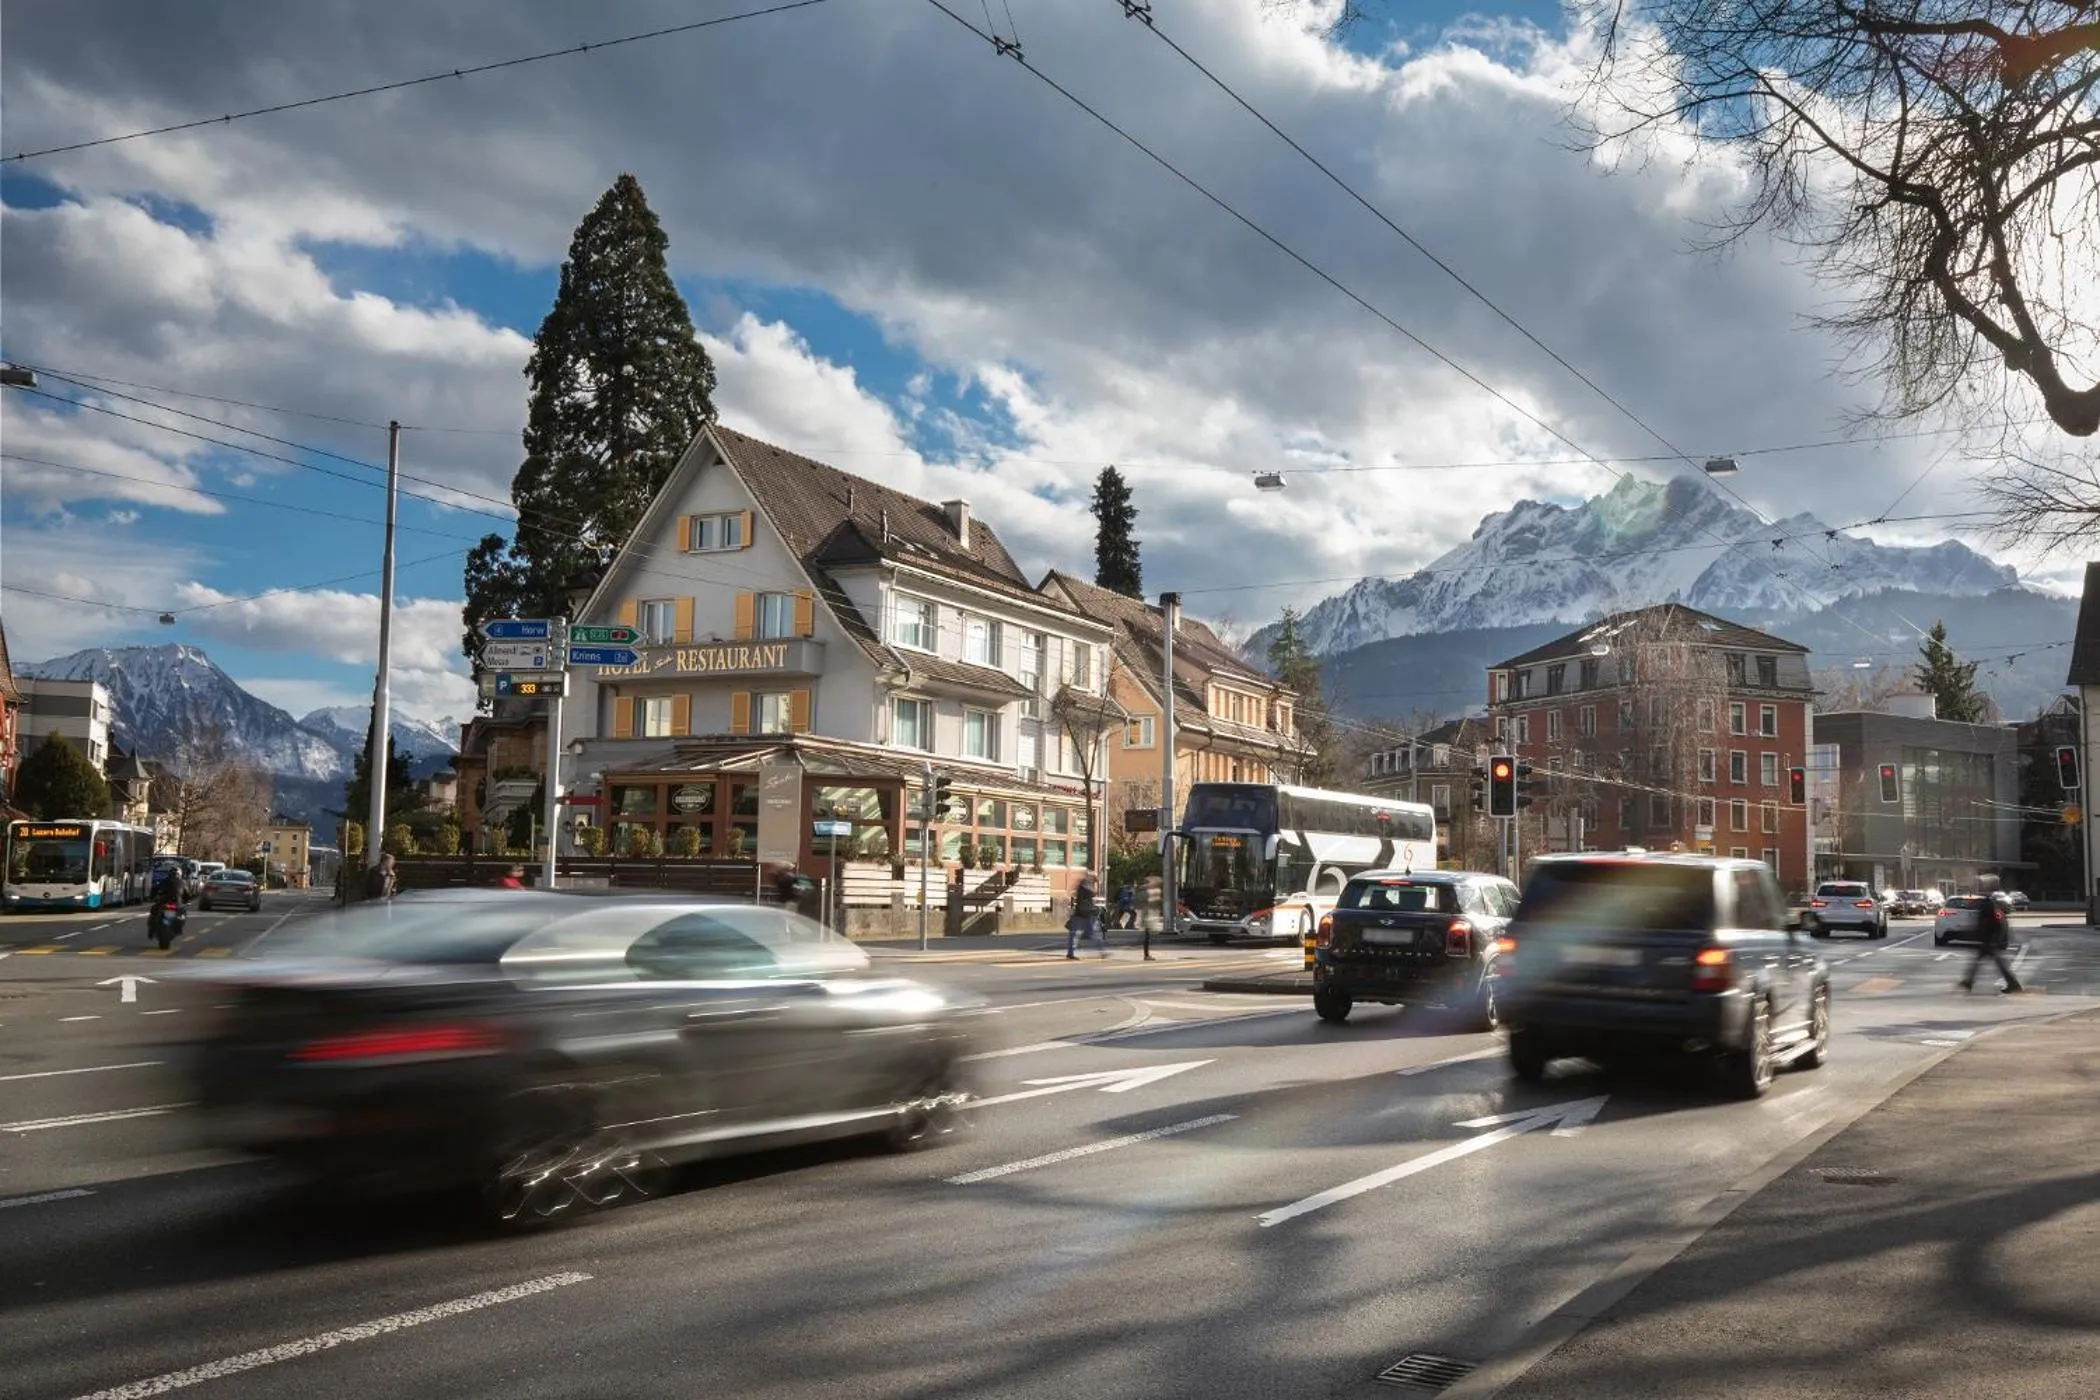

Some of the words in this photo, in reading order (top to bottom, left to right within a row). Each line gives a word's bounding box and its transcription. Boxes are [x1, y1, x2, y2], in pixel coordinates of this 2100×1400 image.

[522, 625, 545, 635] Horw
[572, 650, 601, 661] Kriens
[676, 644, 788, 672] RESTAURANT
[521, 684, 536, 693] 333
